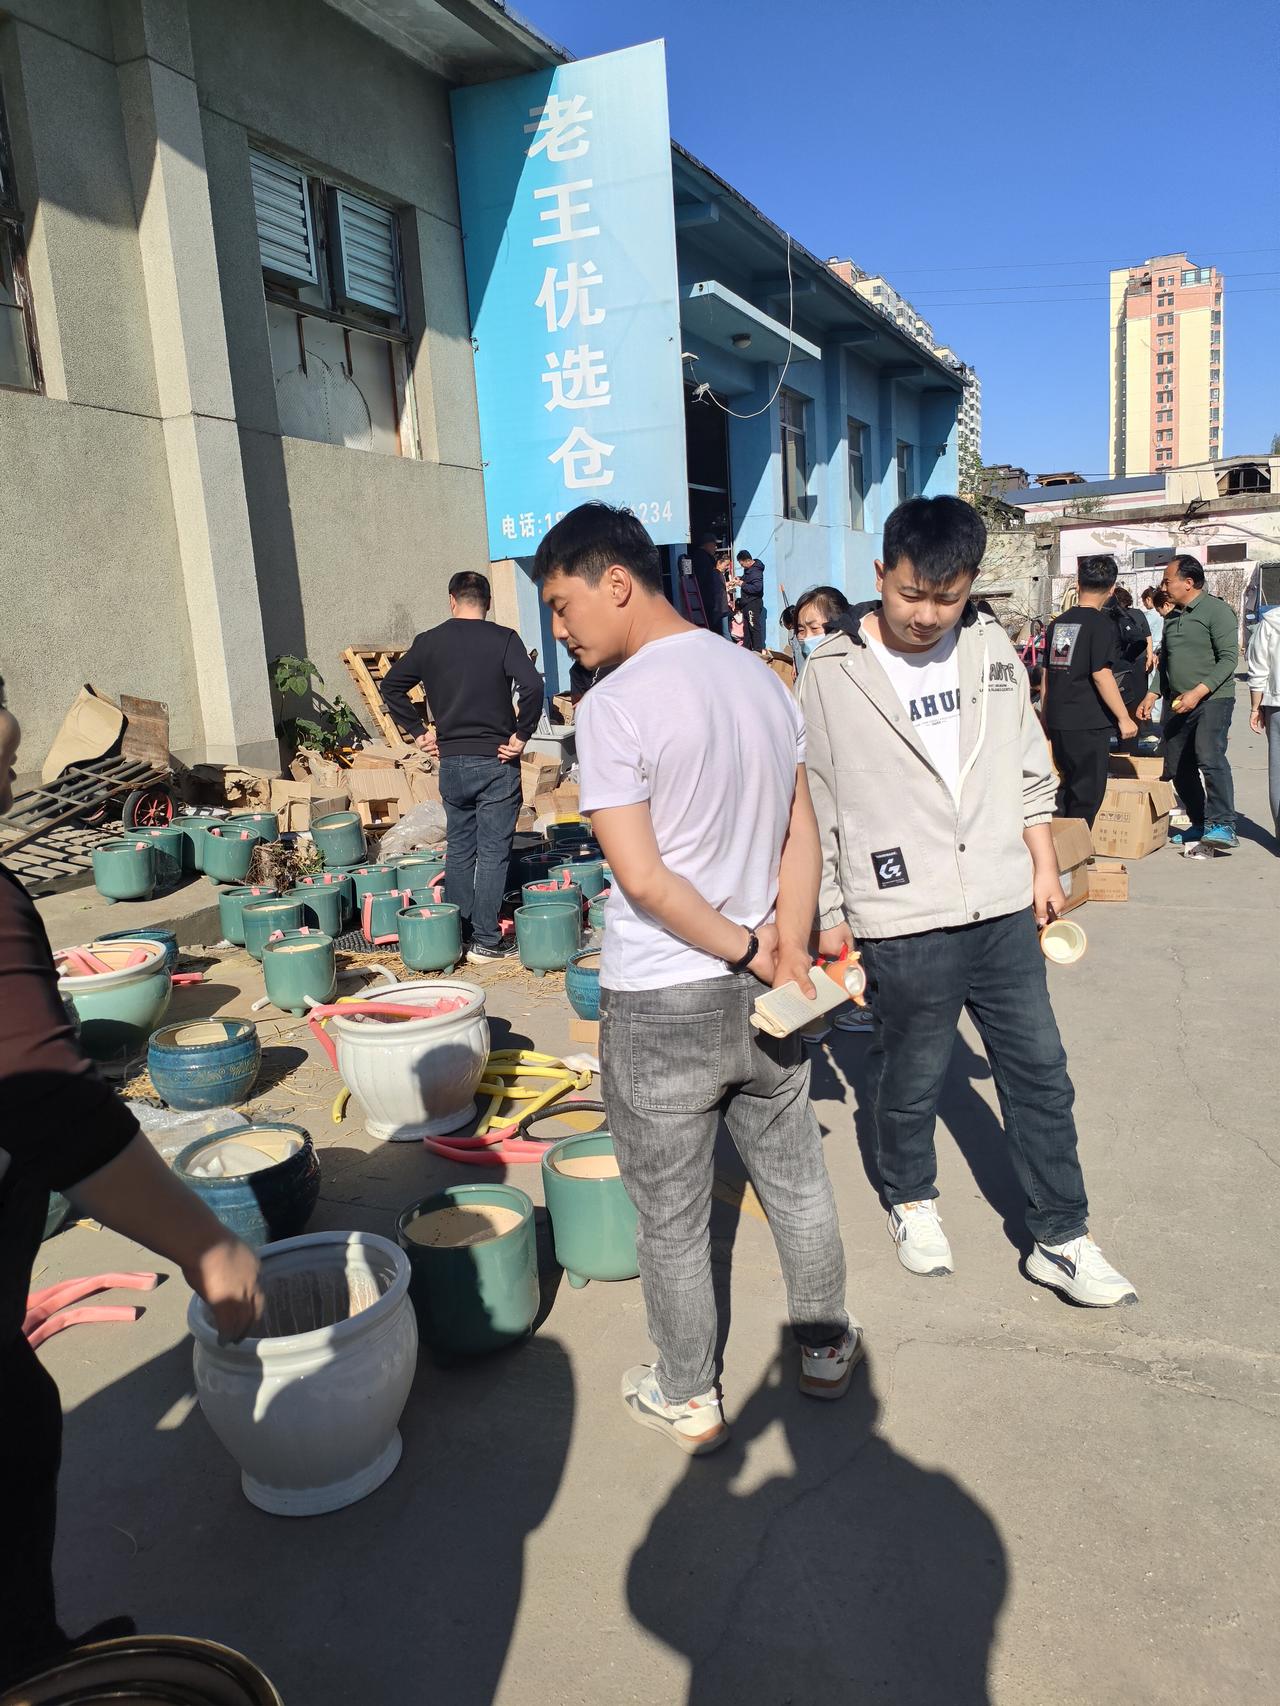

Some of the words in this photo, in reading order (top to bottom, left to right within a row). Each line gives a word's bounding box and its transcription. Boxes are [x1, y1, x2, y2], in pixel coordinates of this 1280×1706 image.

[523, 94, 616, 489] 老王优选仓
[909, 688, 961, 722] AHU
